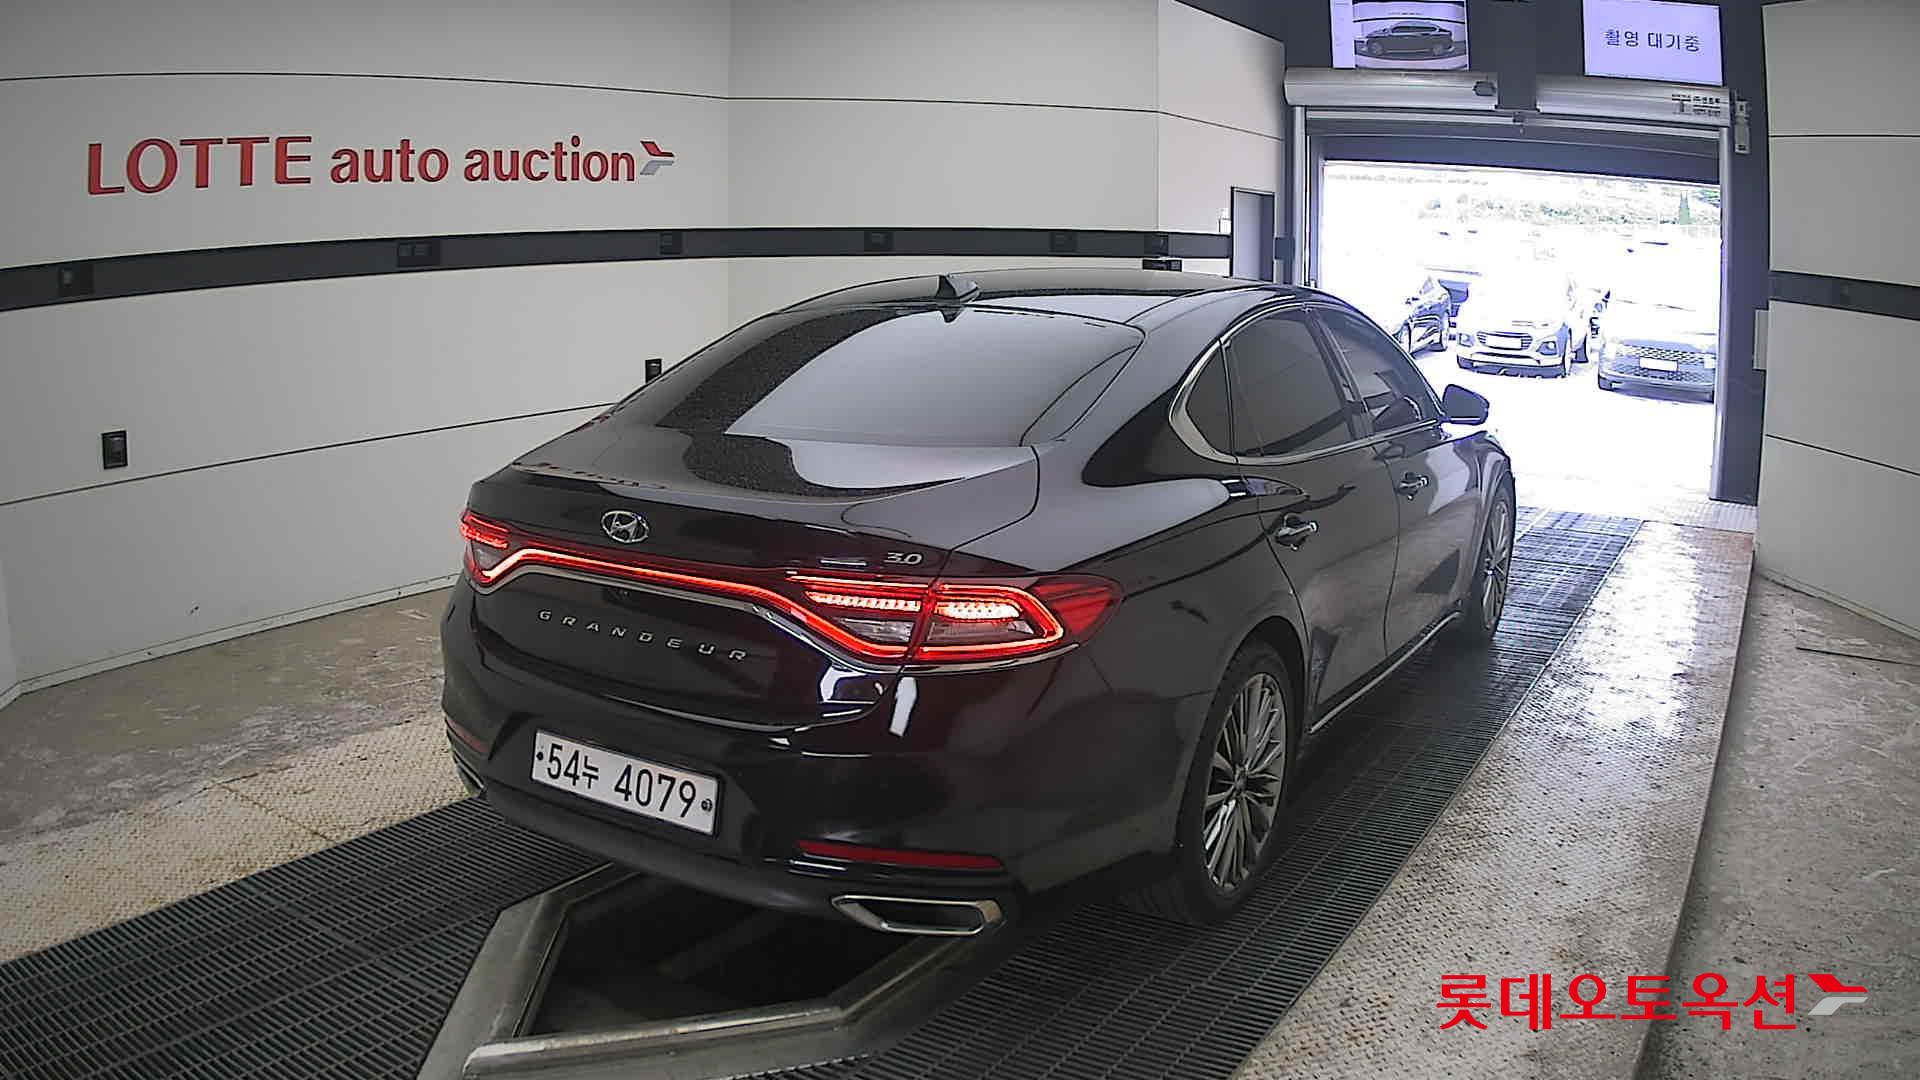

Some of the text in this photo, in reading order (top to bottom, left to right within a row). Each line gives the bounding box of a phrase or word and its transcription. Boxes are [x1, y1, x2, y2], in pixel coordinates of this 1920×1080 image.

[1647, 32, 1700, 52] 대기중
[87, 135, 637, 196] LOTTE auto auction
[537, 609, 748, 662] GRANDEUR
[547, 743, 697, 818] 54누 4079
